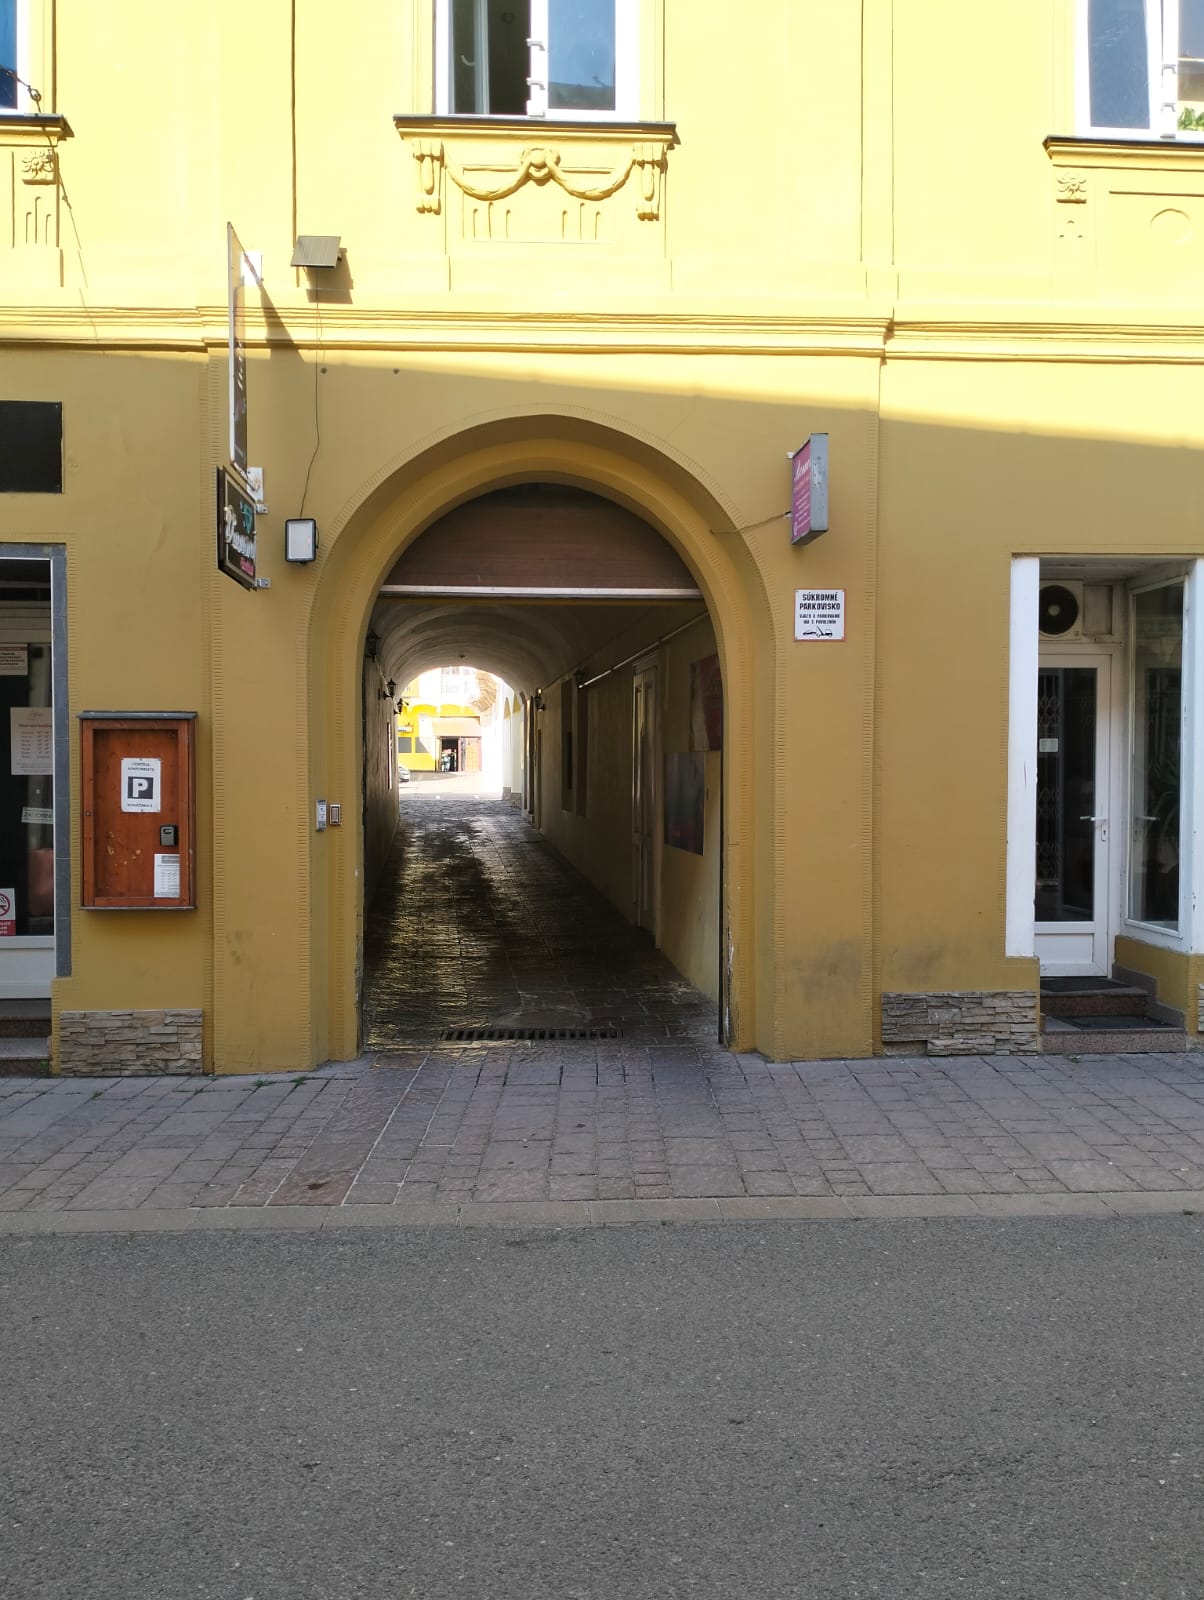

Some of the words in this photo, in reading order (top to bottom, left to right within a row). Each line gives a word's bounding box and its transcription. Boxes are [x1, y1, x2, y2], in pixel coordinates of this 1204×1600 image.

[802, 592, 838, 601] SÚKROMNÉ
[800, 602, 840, 610] PARKOVISKO
[133, 778, 148, 797] P
